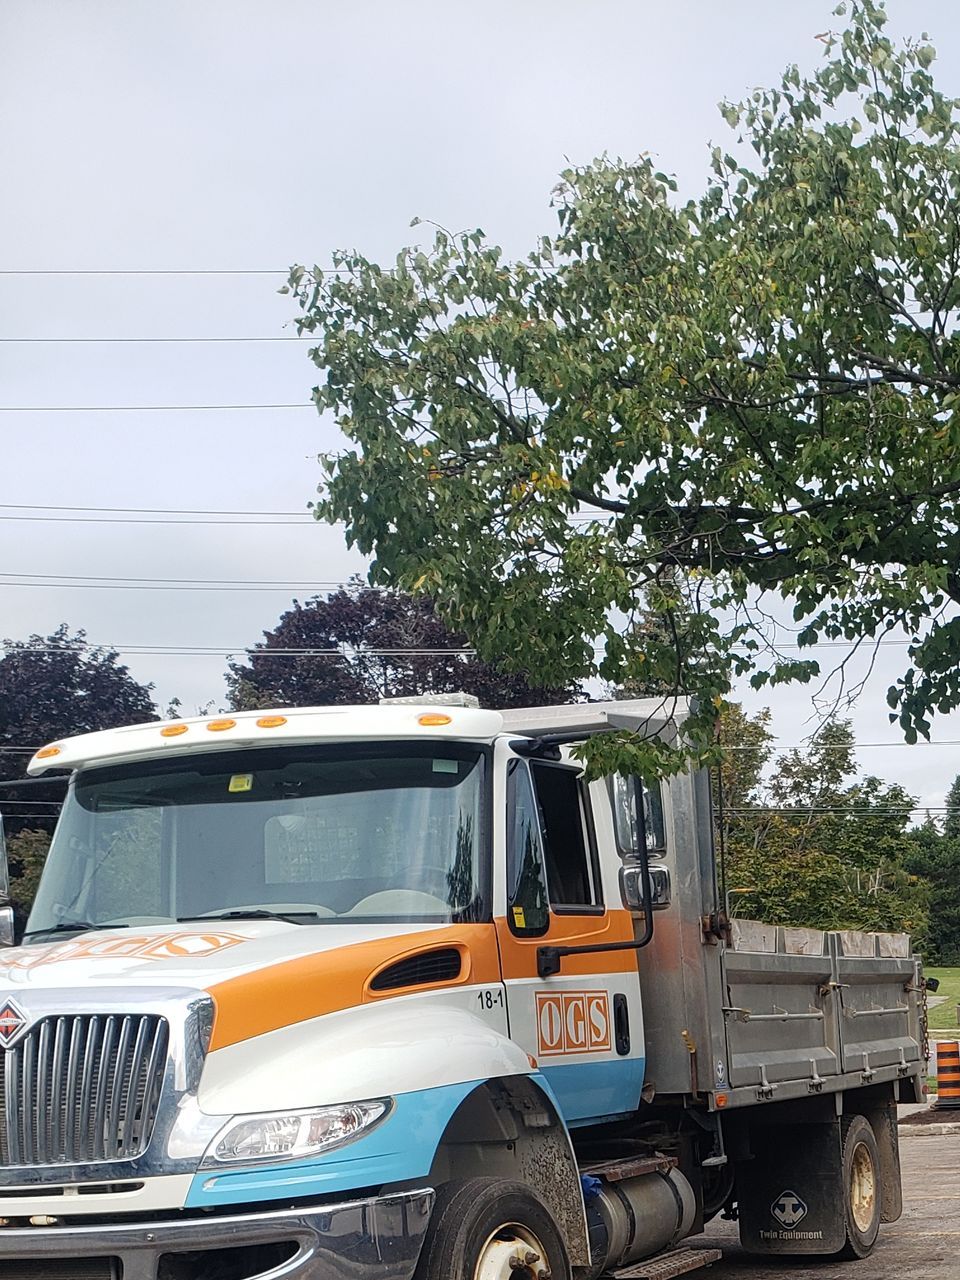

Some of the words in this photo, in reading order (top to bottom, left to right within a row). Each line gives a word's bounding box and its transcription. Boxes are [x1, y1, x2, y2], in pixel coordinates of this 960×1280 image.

[478, 989, 504, 1010] 18-1
[539, 998, 608, 1047] OGS
[760, 1230, 778, 1239] Twin
[779, 1230, 823, 1240] Equipment
